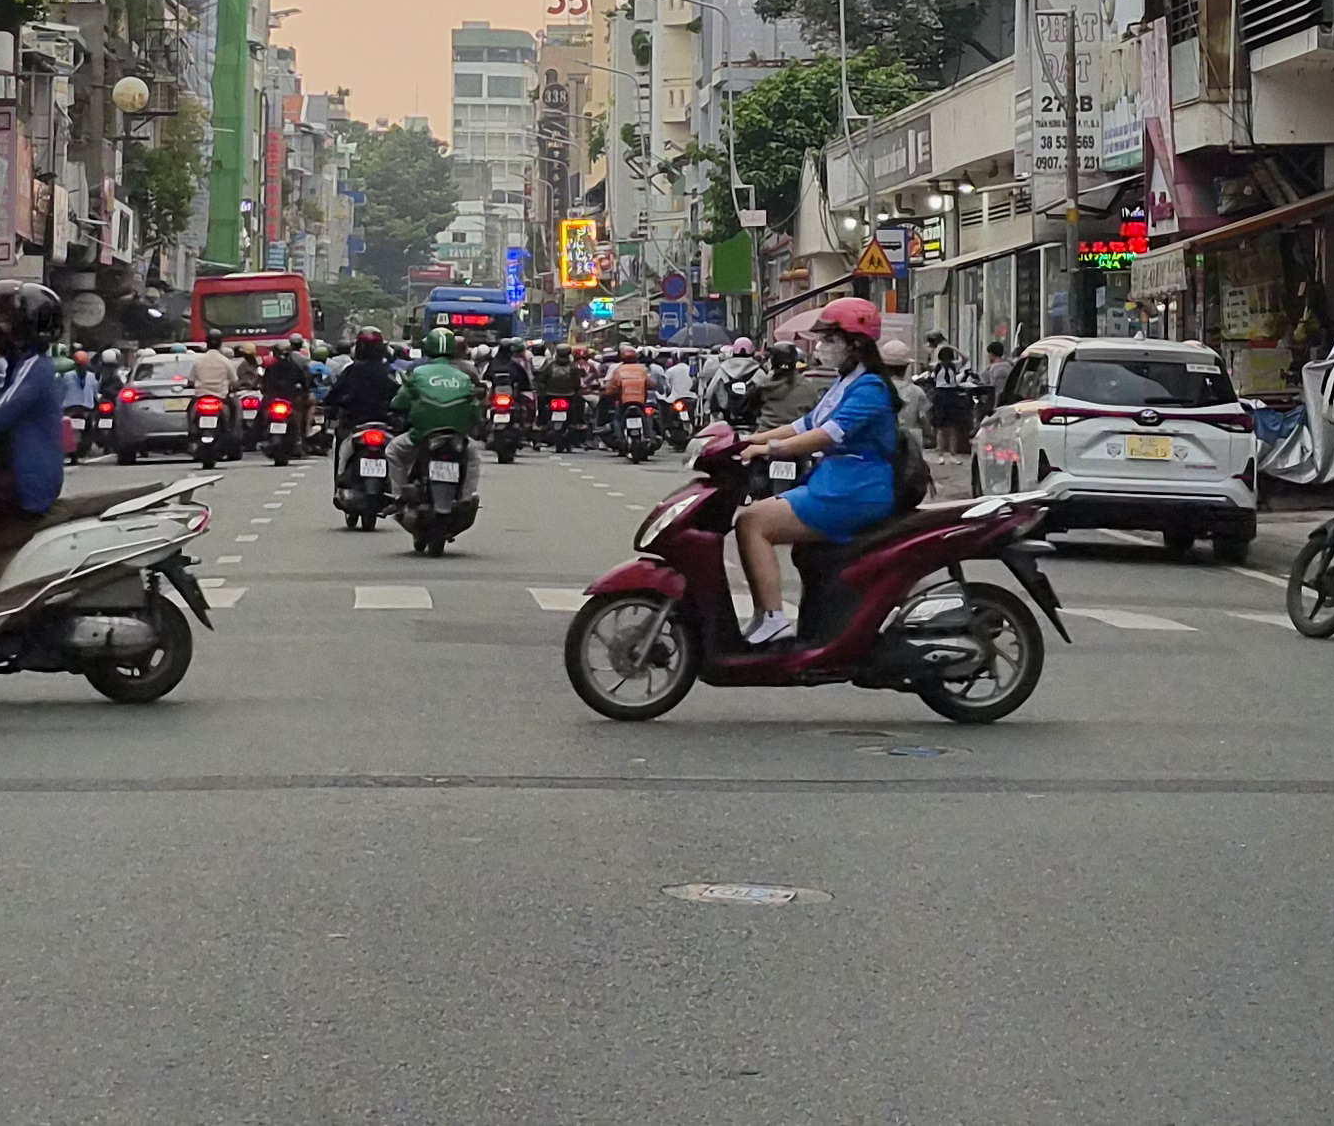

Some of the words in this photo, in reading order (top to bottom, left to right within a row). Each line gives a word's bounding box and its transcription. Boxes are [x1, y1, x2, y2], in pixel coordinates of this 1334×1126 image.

[1041, 96, 1093, 112] 27B
[1040, 135, 1052, 149] 38
[428, 375, 460, 389] Grab
